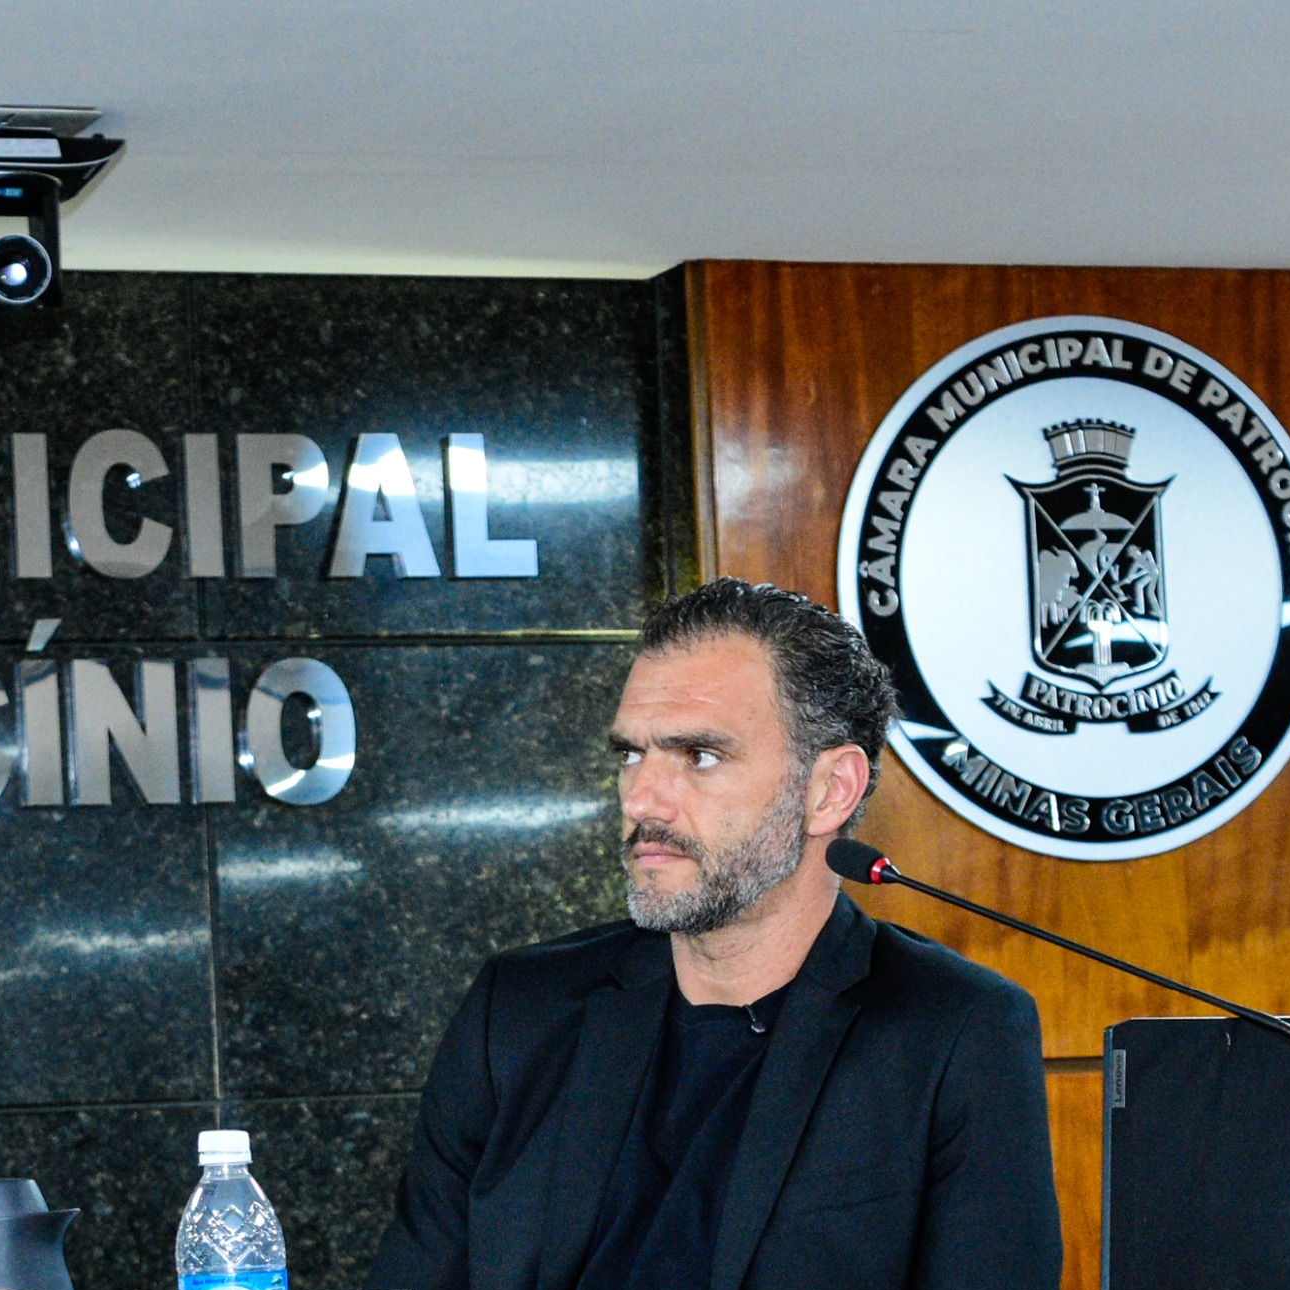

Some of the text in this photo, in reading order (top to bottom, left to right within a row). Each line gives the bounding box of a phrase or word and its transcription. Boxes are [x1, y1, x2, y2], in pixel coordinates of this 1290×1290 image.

[859, 436, 938, 617] CÂMARA
[926, 337, 1133, 433] MUNICIPAL
[1143, 347, 1198, 395] DE
[1158, 707, 1181, 729] DE
[941, 734, 1263, 835] MINAS GERAIS
